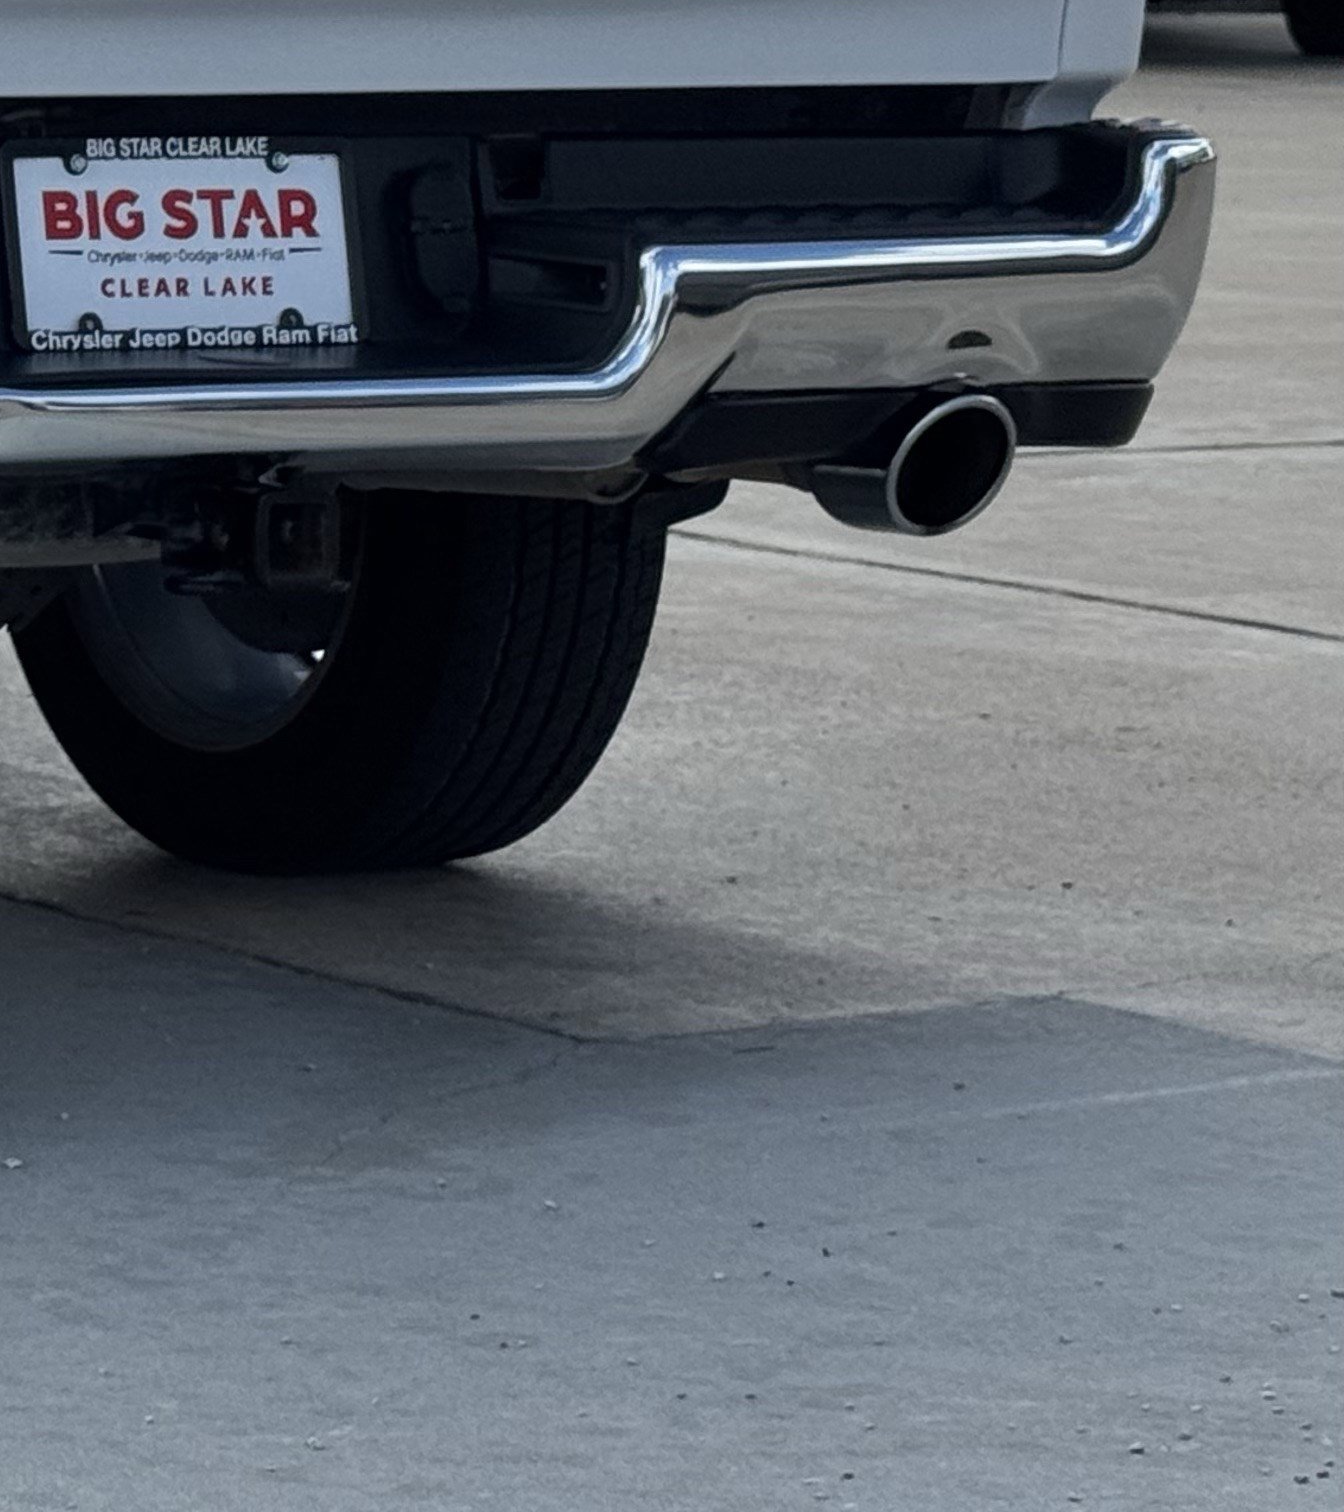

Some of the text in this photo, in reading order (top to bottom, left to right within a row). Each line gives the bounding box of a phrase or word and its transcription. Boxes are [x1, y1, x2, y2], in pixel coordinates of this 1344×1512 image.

[86, 137, 268, 157] BIG STAR CLEAR LAKE
[42, 189, 320, 240] BIG STAR
[100, 276, 275, 298] CLEAR LAKE
[31, 325, 358, 352] Chrysler Jeep Dodge Ram Fiat
